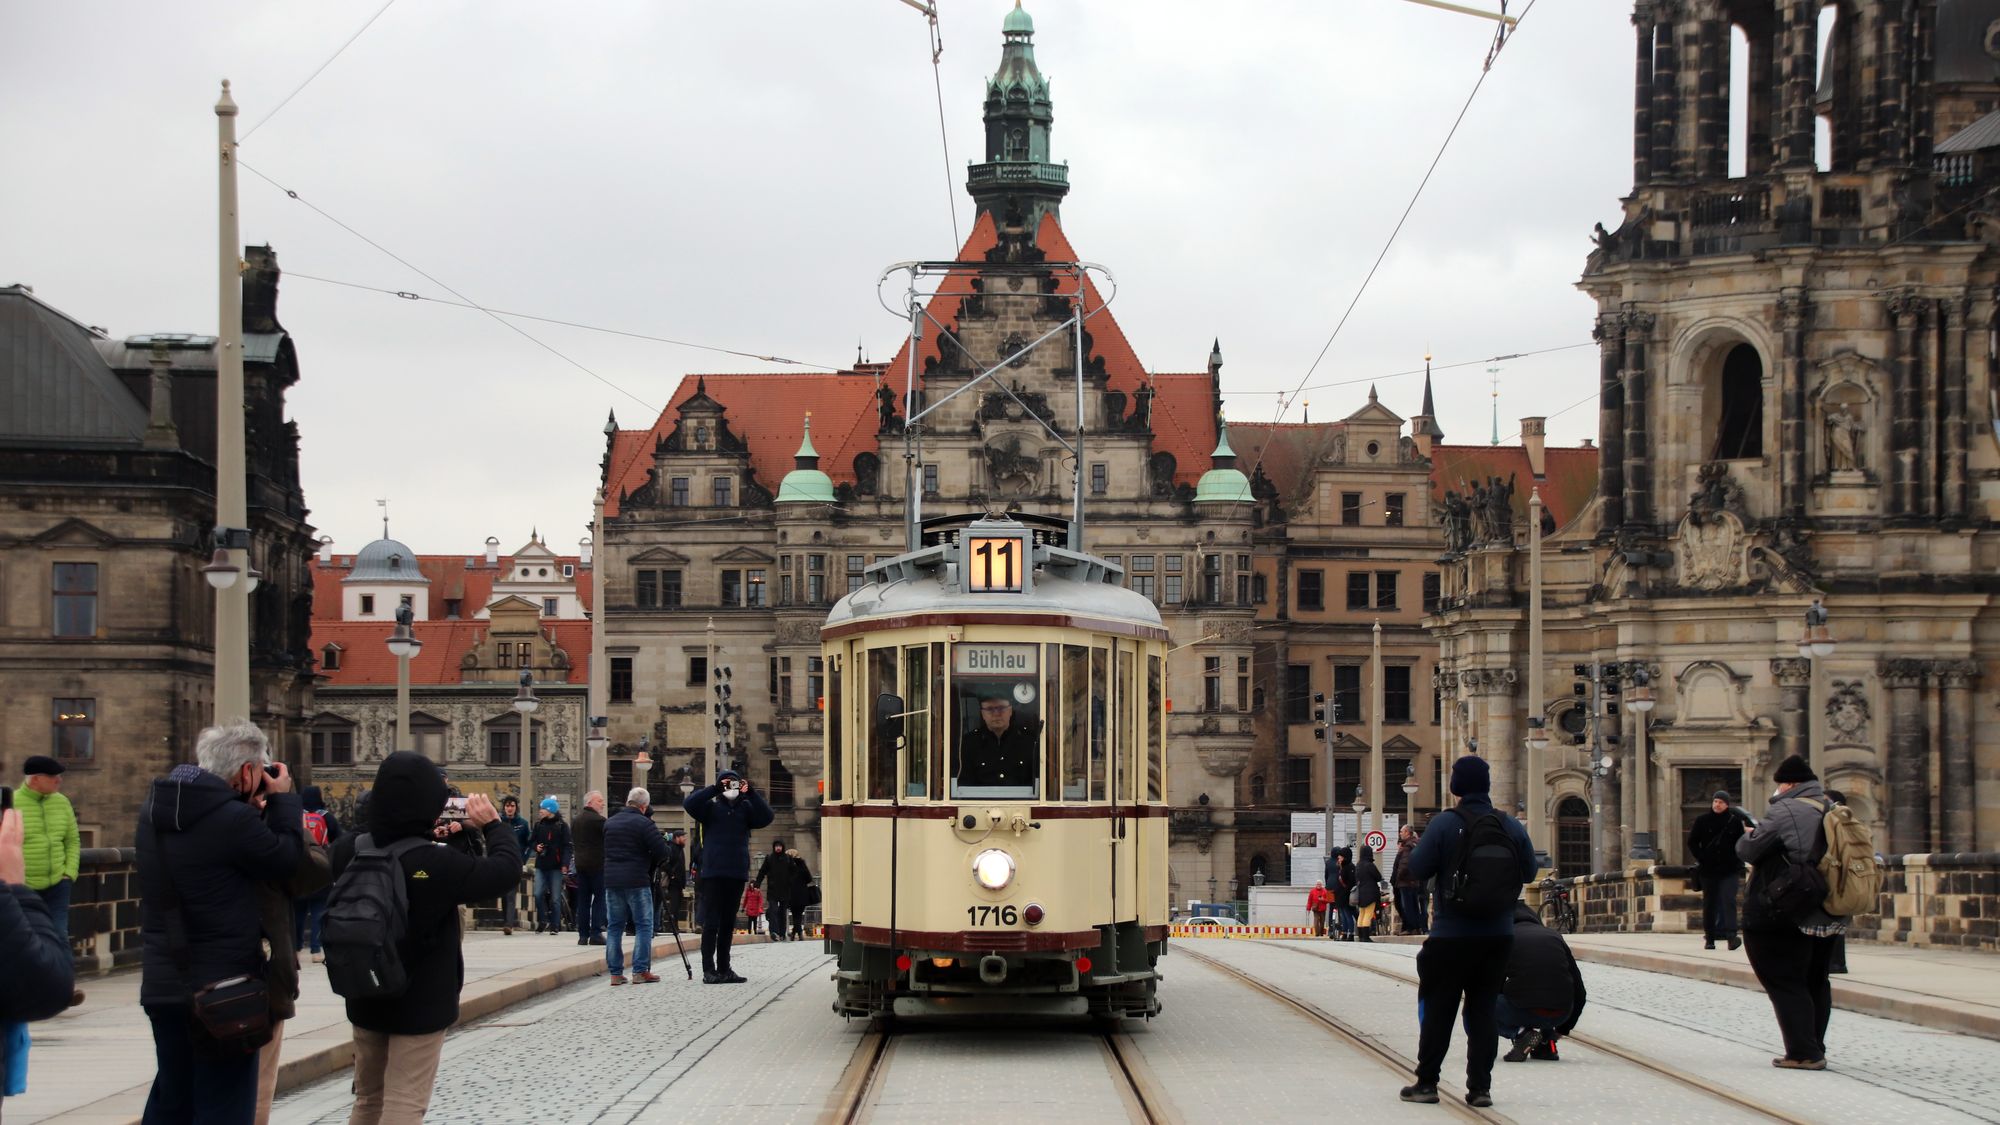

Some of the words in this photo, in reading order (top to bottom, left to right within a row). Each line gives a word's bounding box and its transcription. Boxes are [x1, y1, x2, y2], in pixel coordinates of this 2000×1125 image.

[977, 542, 1013, 588] 11
[968, 649, 1026, 669] Bühlau
[1369, 836, 1382, 847] 30
[967, 904, 1018, 926] 1716
